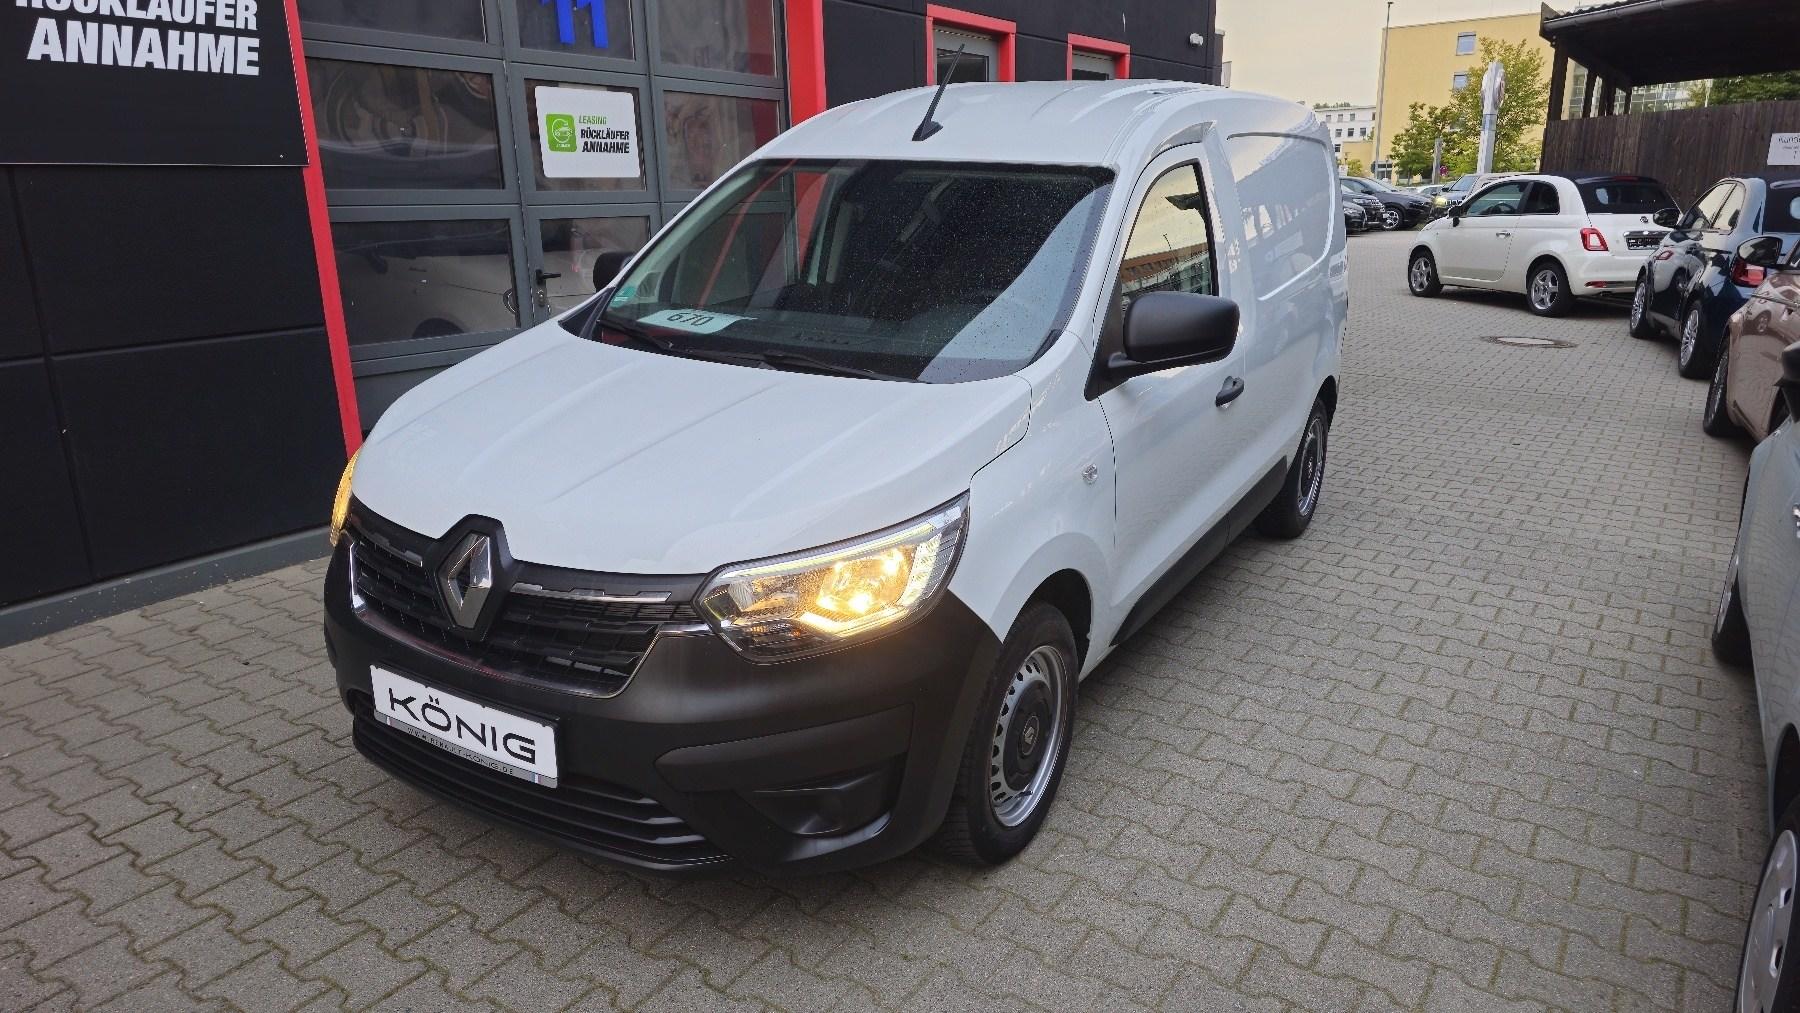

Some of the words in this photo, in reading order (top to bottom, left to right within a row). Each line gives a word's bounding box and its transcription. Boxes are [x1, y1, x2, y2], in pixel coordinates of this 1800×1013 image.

[26, 17, 260, 76] ANNAHME
[578, 115, 607, 125] LEASING
[580, 127, 630, 140] RÜCKLÄUFER
[582, 141, 630, 154] ANNAHME
[667, 312, 715, 327] 670
[388, 687, 536, 765] KÖNIG
